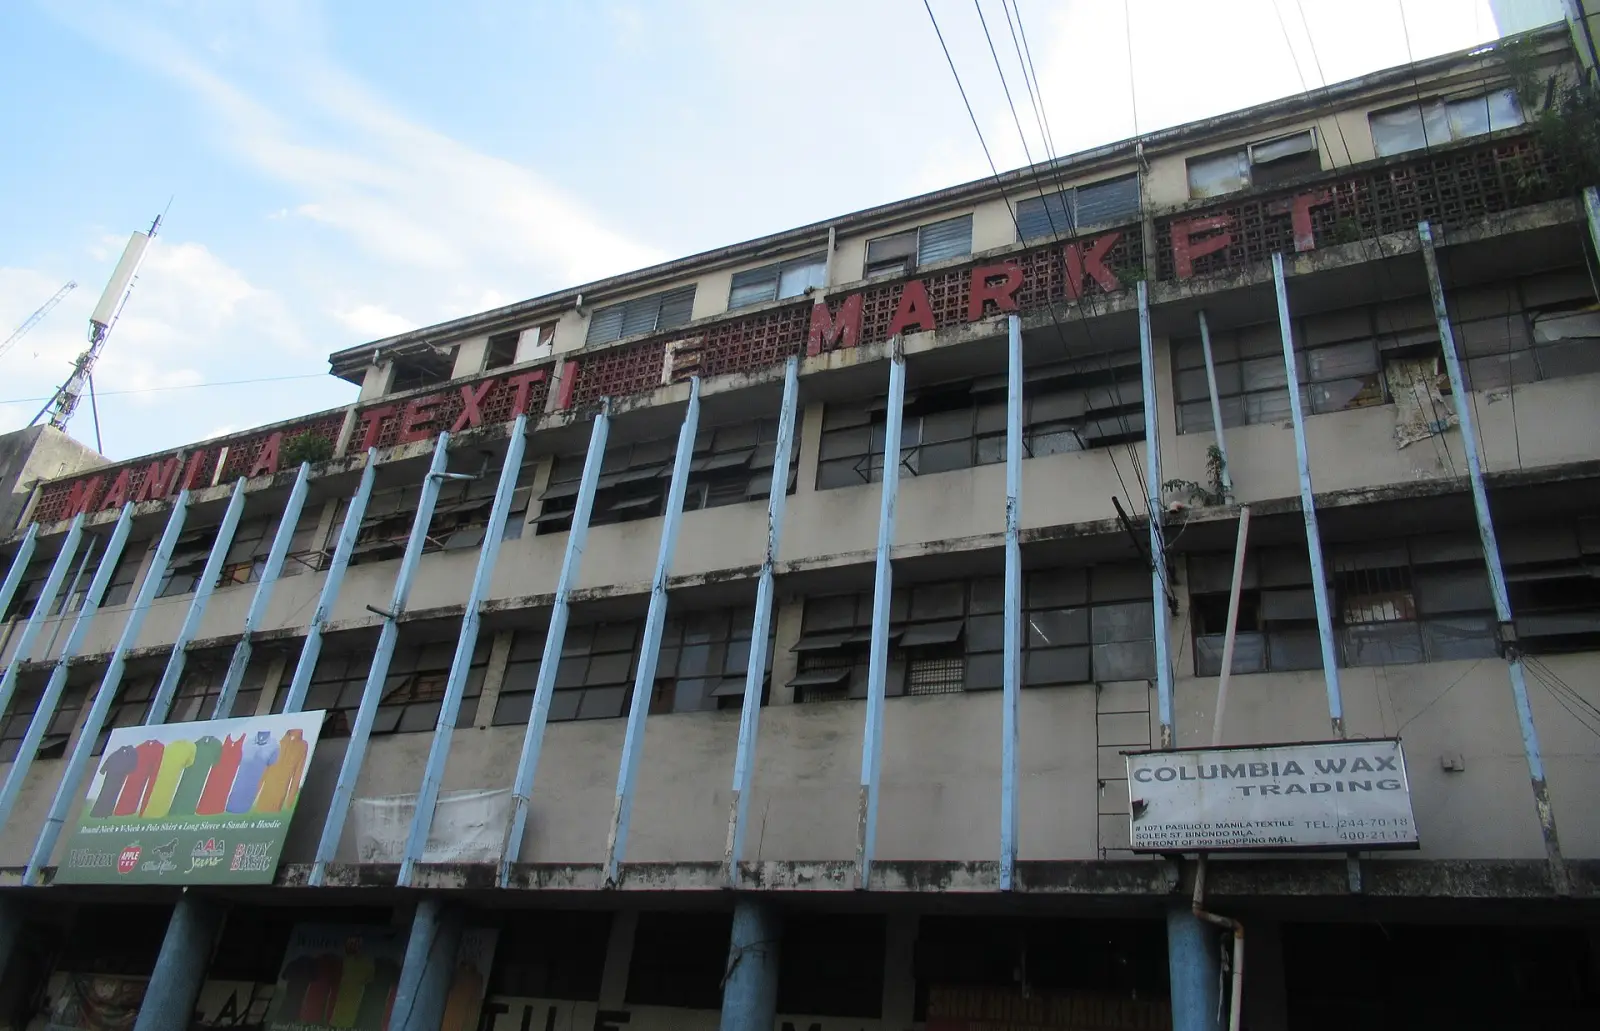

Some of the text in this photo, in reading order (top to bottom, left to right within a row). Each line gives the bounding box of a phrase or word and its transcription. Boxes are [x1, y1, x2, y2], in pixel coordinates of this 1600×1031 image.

[361, 336, 706, 452] TEXTIE
[1134, 756, 1398, 783] COLUMBIA WAX
[1236, 779, 1401, 797] TRADING
[99, 825, 115, 833] Neck
[145, 823, 160, 831] Polo
[161, 822, 178, 831] Shirt
[183, 822, 200, 832] Long
[200, 821, 221, 830] Sleeve
[226, 820, 248, 829] Sando
[256, 819, 282, 829] Hoodie
[1255, 820, 1295, 828] TEXTILE
[1304, 818, 1408, 829] TEL. 244-70-18
[1185, 830, 1230, 838] BINONDO
[1215, 838, 1266, 846] SHOPPING
[1268, 836, 1296, 844] MALL
[1340, 830, 1408, 840] 400-21-17
[194, 837, 225, 851] AAA
[234, 840, 275, 857] BODY
[121, 851, 140, 860] APPLE
[230, 855, 272, 872] BASIC
